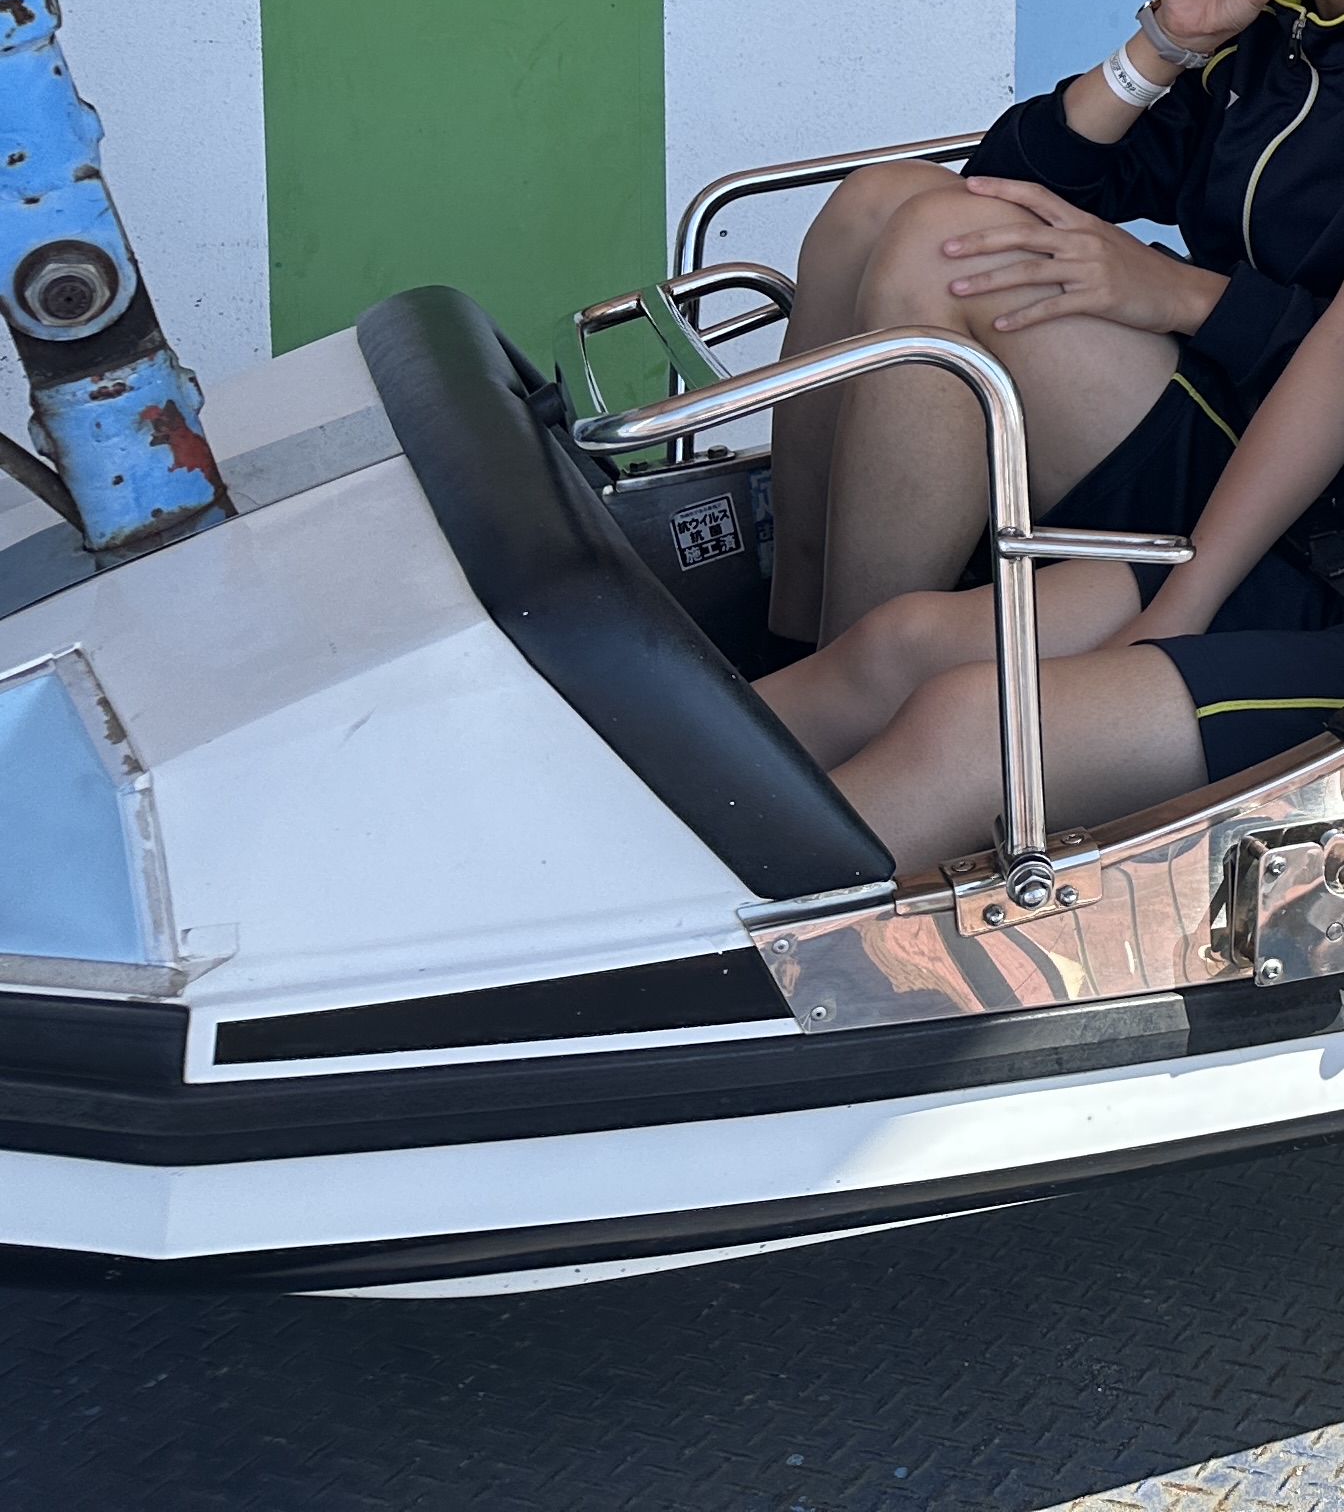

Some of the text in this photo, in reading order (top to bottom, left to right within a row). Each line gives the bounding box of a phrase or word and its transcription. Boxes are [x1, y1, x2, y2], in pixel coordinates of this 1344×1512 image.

[677, 509, 731, 535] 抗ウイルス
